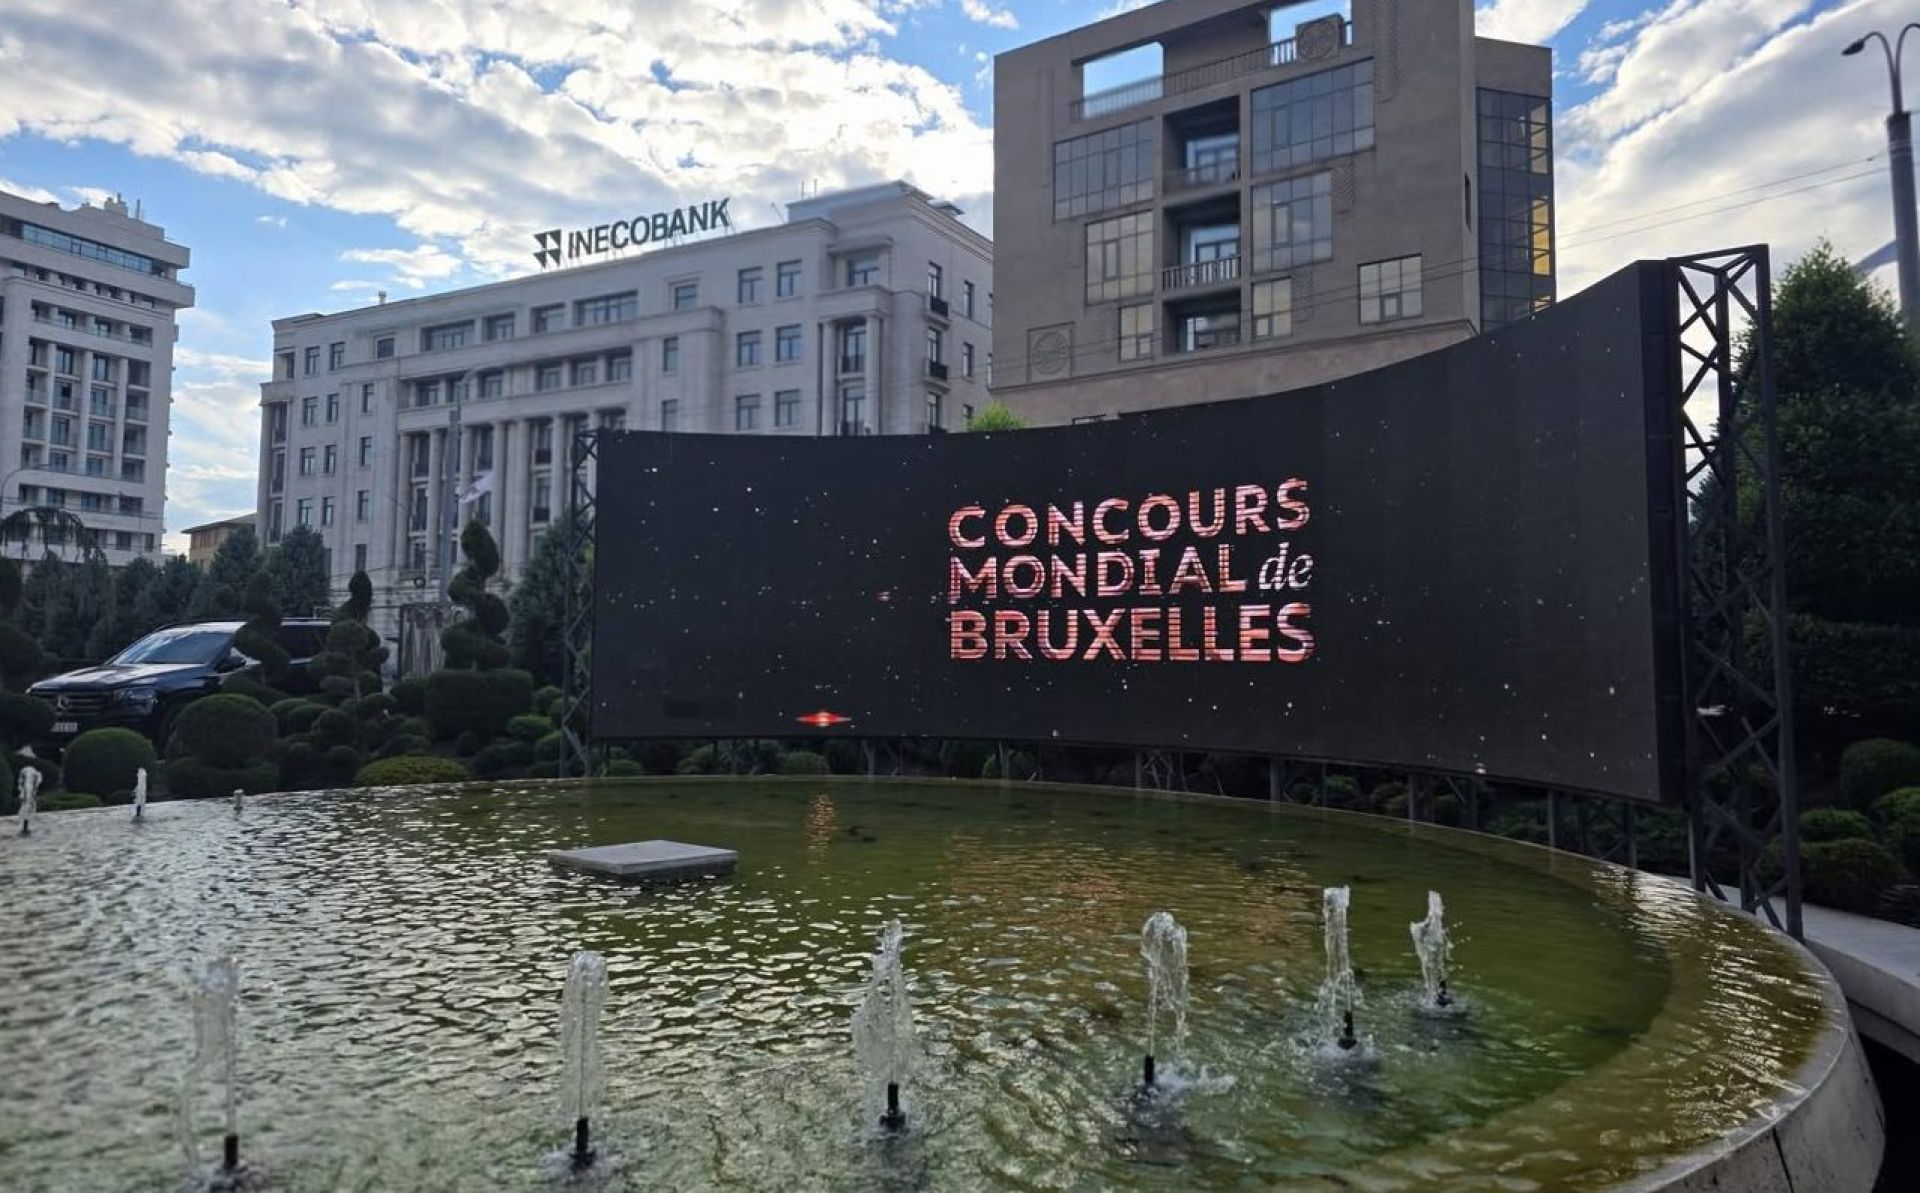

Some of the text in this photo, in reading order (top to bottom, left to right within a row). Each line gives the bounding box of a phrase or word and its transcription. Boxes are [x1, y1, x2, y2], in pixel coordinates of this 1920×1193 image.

[568, 198, 730, 258] INECOBANK
[948, 477, 1310, 548] CONCOURS
[949, 542, 1313, 602] MONDIAL de
[950, 602, 1315, 662] BRUXELLES
